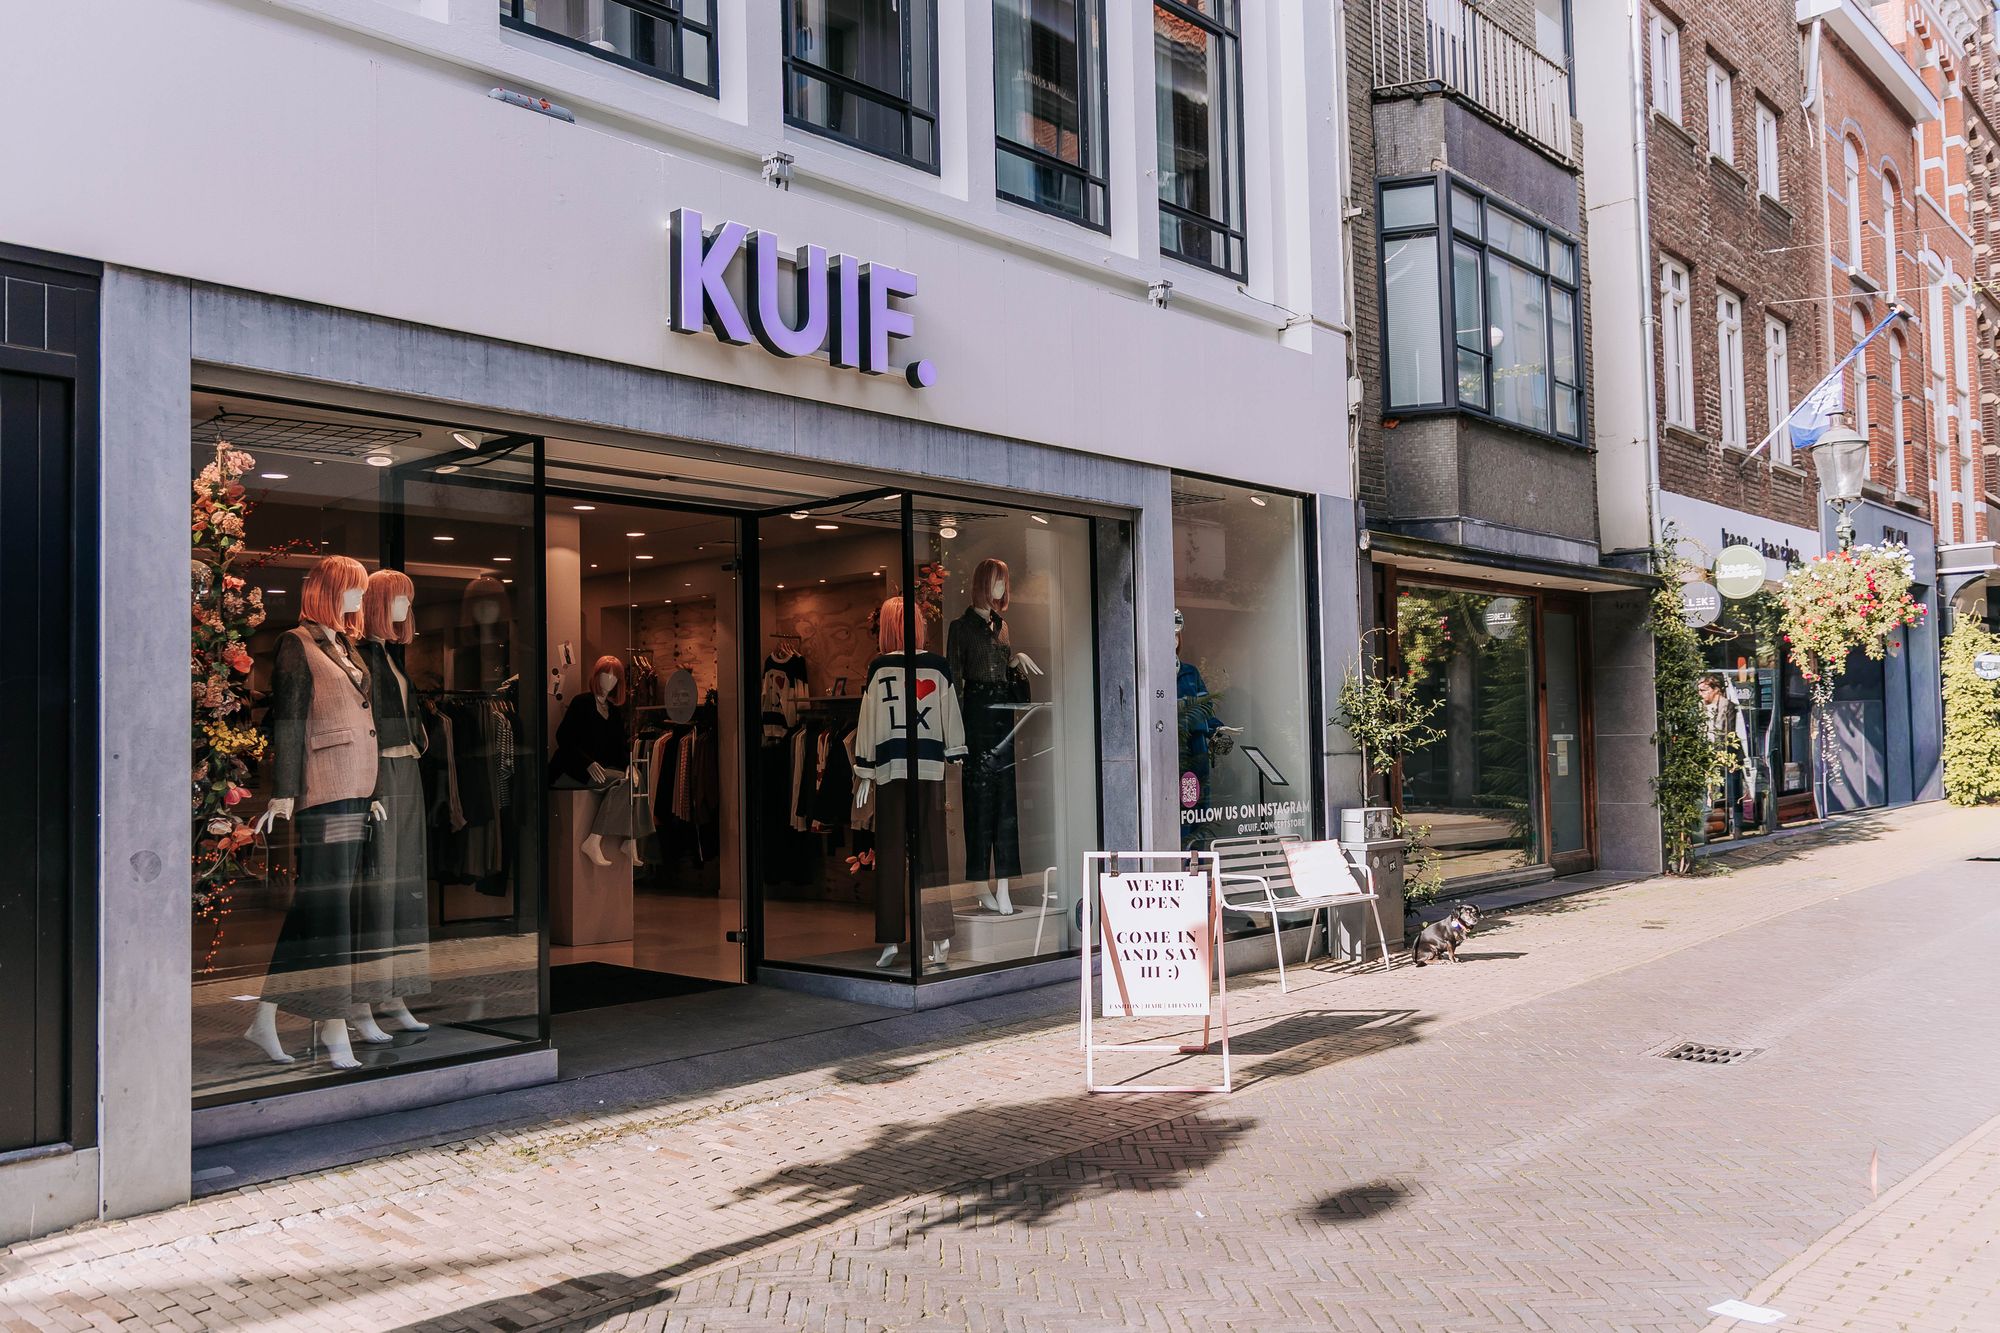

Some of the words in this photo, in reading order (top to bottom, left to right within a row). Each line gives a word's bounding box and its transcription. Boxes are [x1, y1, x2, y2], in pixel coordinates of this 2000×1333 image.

[670, 206, 938, 389] KUIF.
[878, 675, 899, 703] I
[1155, 689, 1165, 699] 56
[1180, 806, 1223, 825] FOLLOW
[1225, 805, 1238, 820] US
[1240, 803, 1256, 819] ON
[1257, 800, 1311, 817] INSTAGRAM
[1237, 818, 1305, 835] @KUIF_CONCEPTSTORE
[1126, 878, 1185, 892] WE'RE
[1131, 896, 1181, 909] OPEN
[1116, 931, 1171, 944] COME
[1178, 930, 1197, 943] IN
[1119, 948, 1158, 961] AND
[1165, 947, 1199, 961] SAY
[1141, 966, 1161, 978] HI
